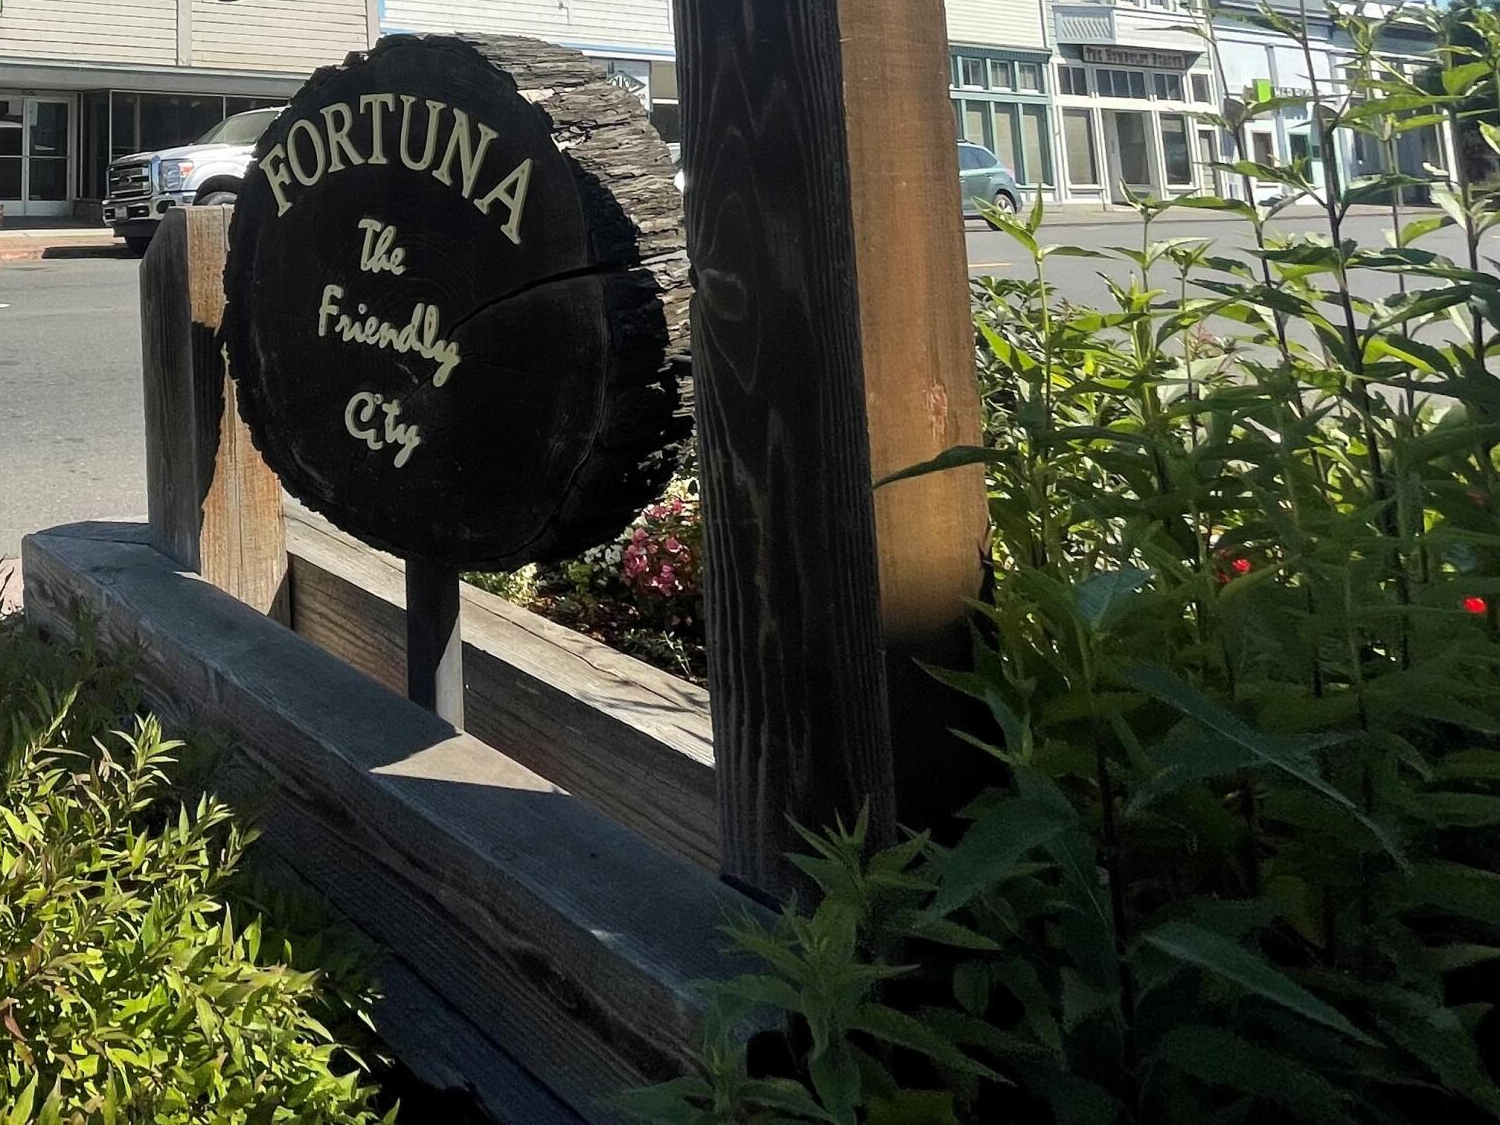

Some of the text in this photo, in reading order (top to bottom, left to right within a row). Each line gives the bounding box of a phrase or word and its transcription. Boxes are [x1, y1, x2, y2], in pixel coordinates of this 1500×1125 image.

[259, 93, 533, 245] FORTUNA
[358, 218, 406, 275] The
[318, 284, 462, 387] Friendly
[345, 391, 421, 467] City
